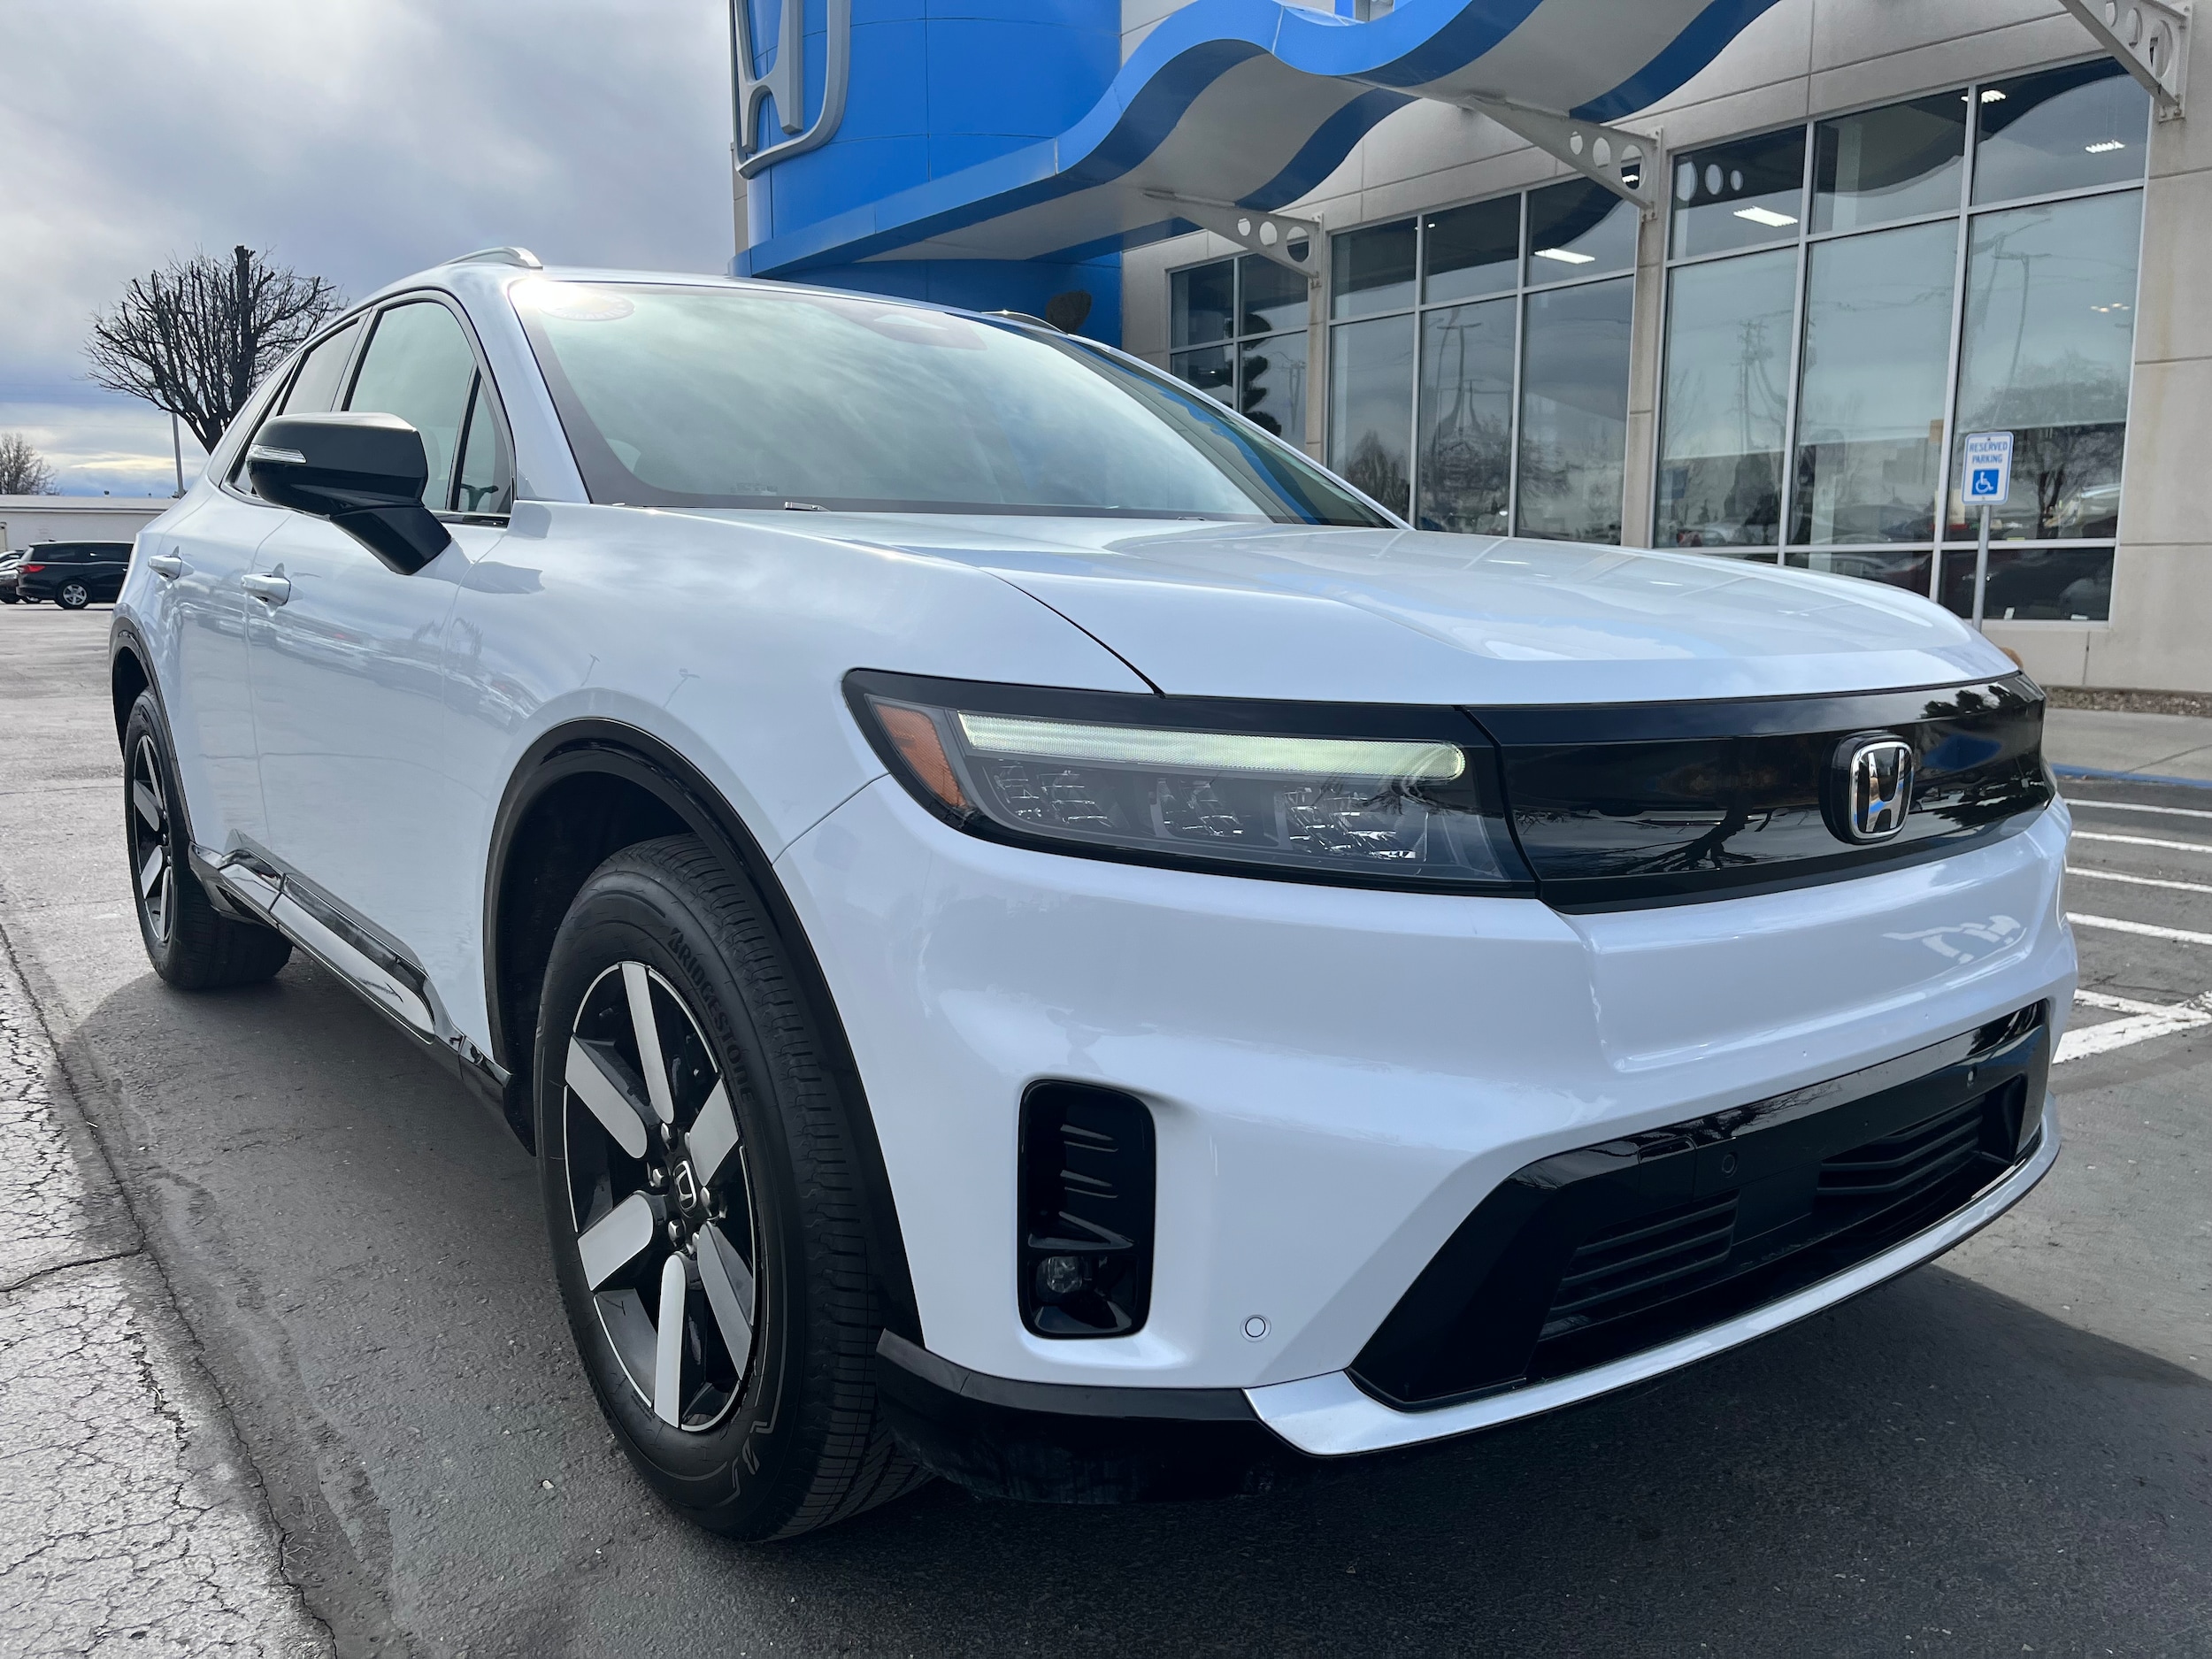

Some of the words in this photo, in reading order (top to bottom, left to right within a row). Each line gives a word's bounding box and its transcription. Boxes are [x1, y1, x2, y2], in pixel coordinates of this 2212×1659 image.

[1970, 442, 2008, 452] RESERVED
[1972, 454, 2002, 463] PARKING
[667, 926, 756, 1103] BRIDGESTONE
